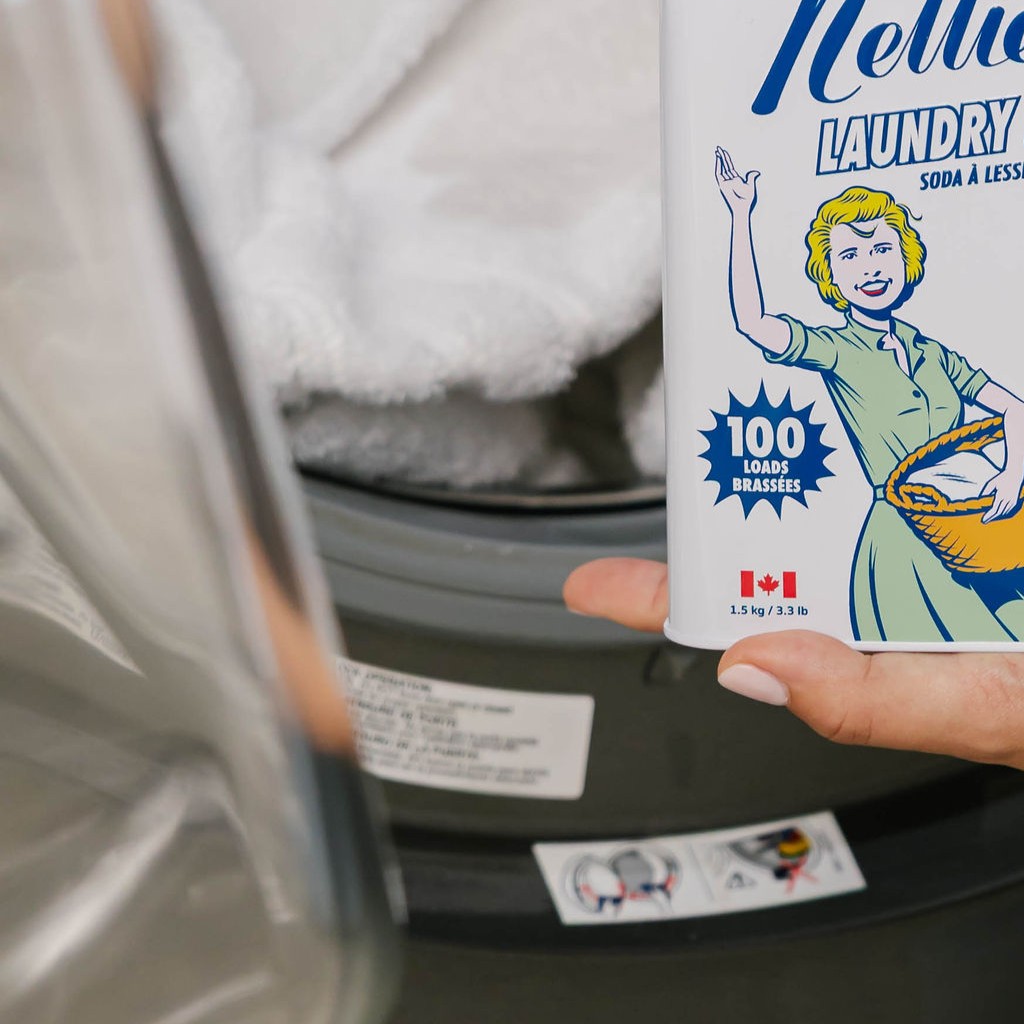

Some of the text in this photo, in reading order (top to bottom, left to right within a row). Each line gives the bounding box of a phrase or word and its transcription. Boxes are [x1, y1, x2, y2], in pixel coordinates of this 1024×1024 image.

[815, 94, 1023, 176] LAUNDRY
[919, 168, 963, 190] SODA
[967, 163, 979, 185] À
[727, 416, 806, 459] 100
[743, 459, 789, 475] LOADS
[732, 475, 801, 494] BRASSÉES
[730, 605, 809, 618] 1.5 kg / 3.3 lb
